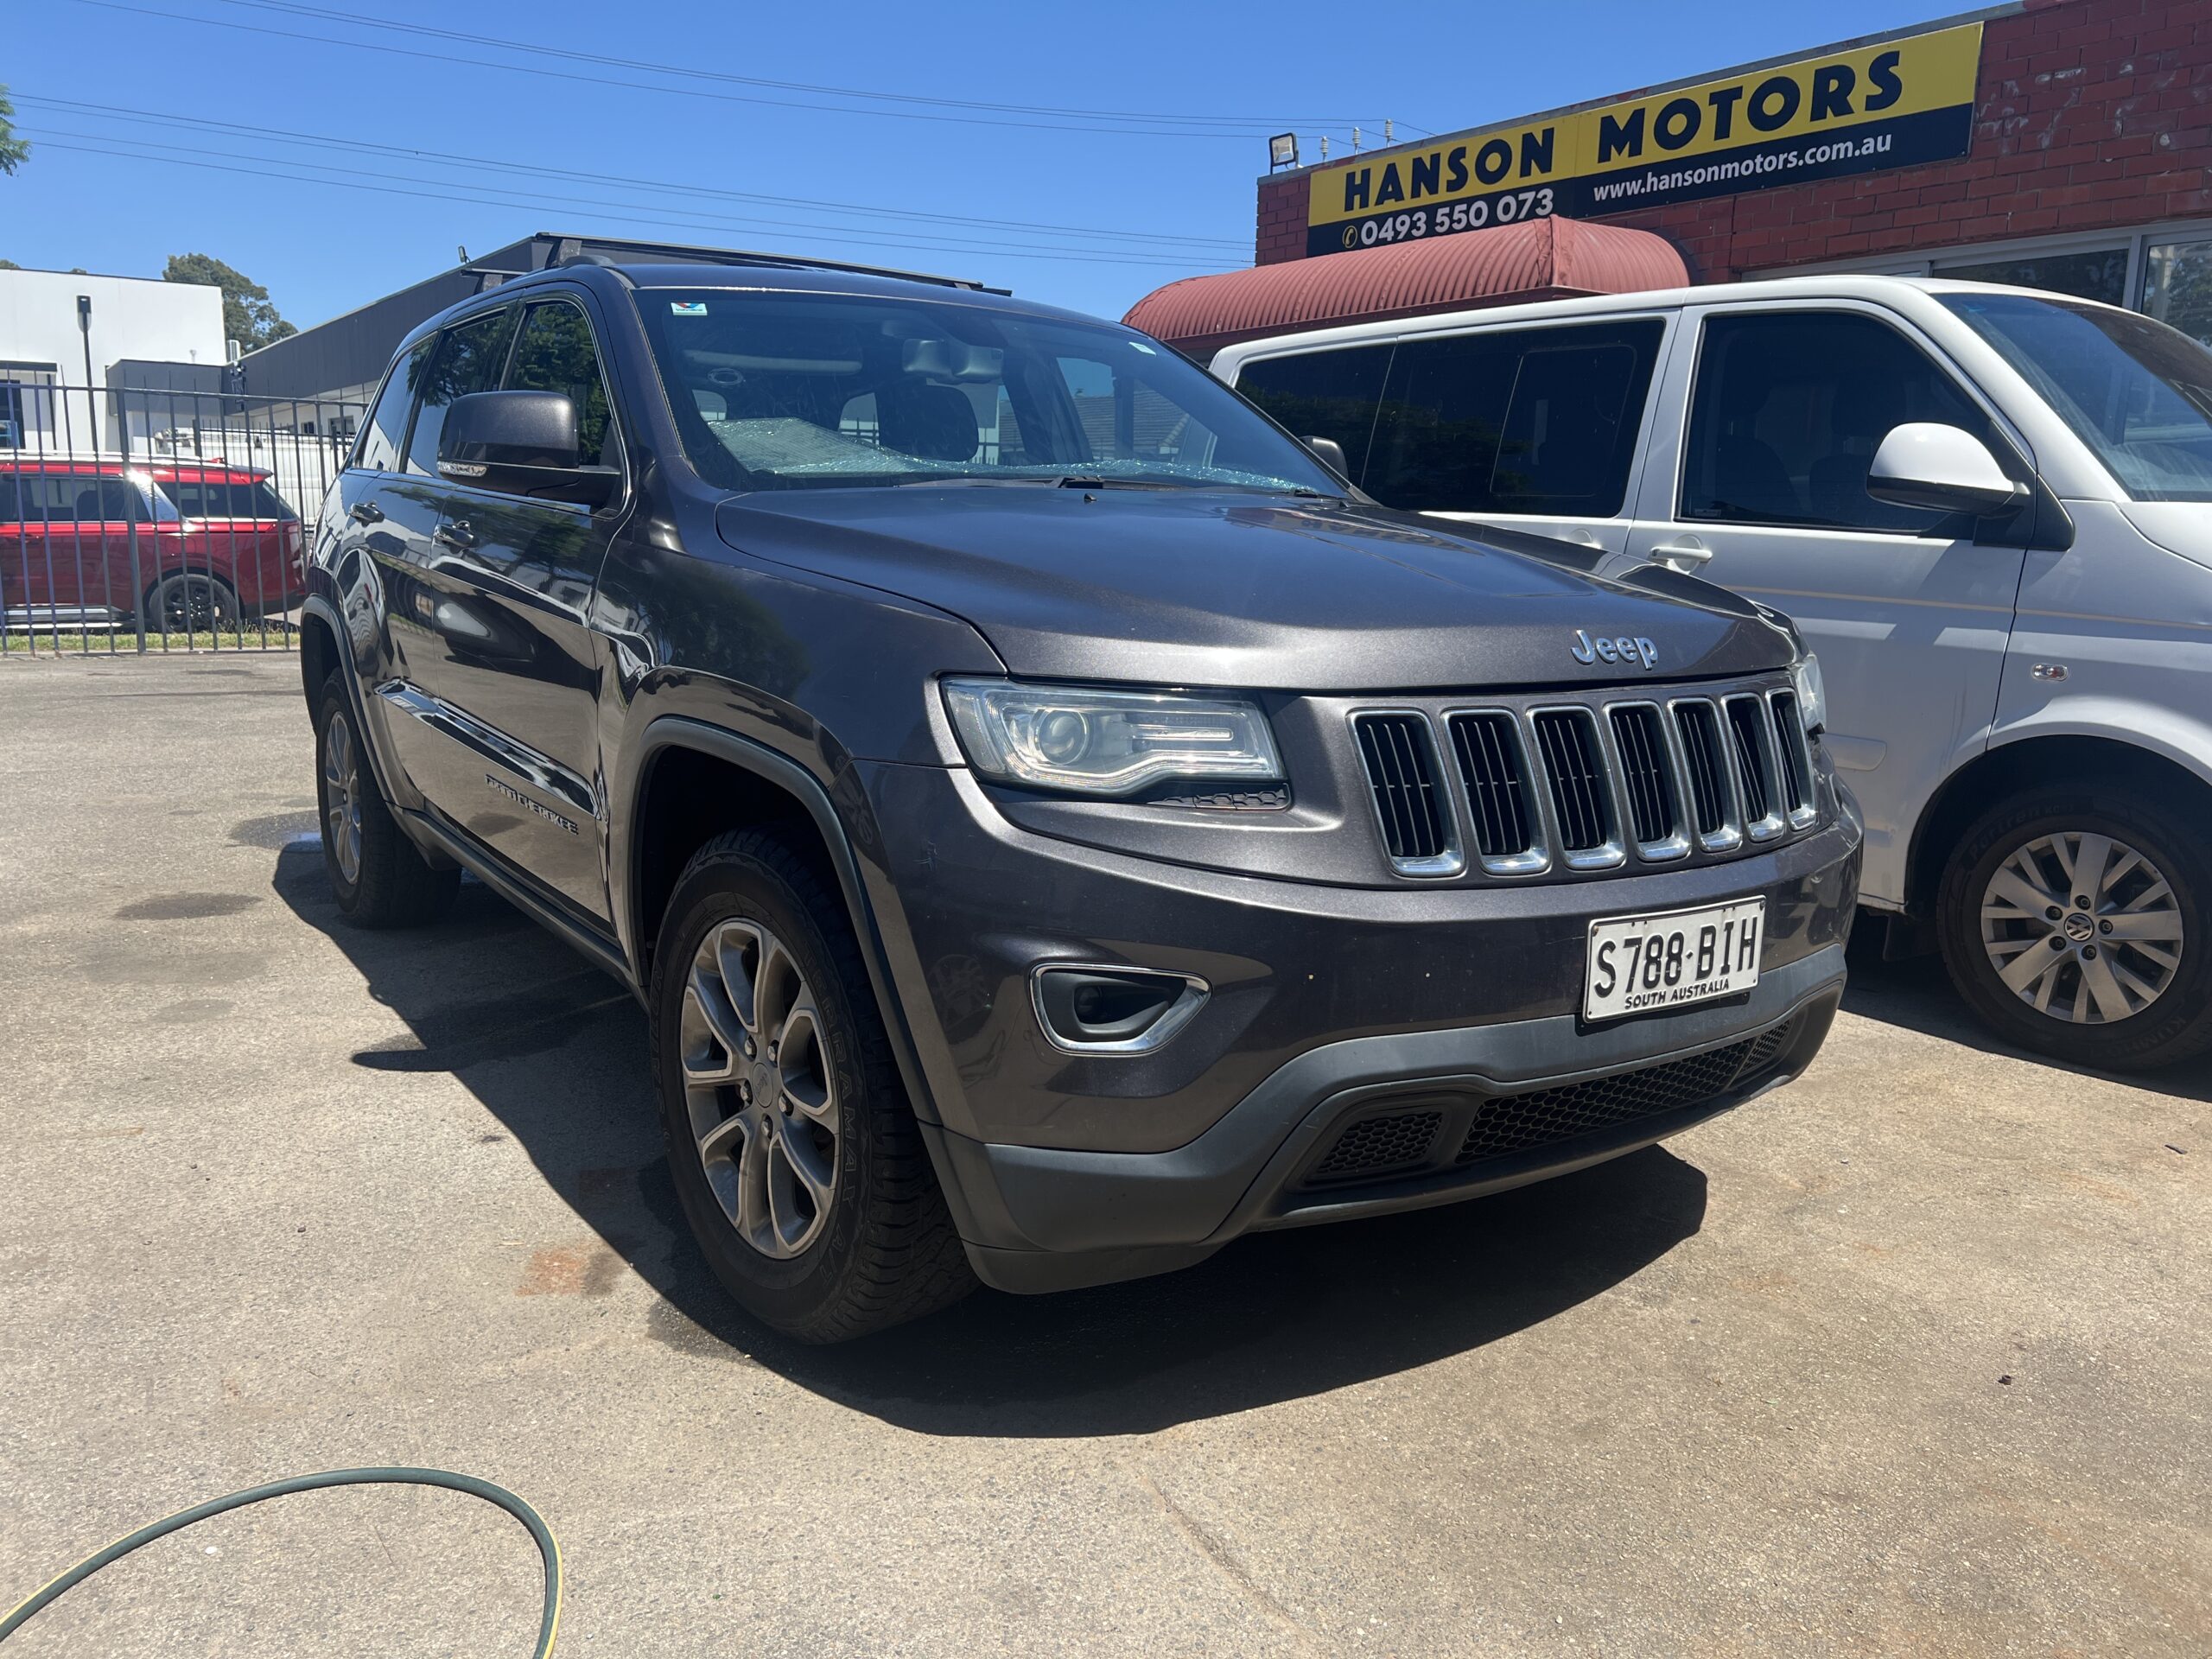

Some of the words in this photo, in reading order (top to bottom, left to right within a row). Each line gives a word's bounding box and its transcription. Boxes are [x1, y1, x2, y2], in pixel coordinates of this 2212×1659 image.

[1344, 127, 1554, 212] HANSON
[1598, 50, 1902, 163] MOTORS
[1593, 133, 1892, 201] www.hansonmotors.com.au
[1360, 211, 1427, 246] 0493
[1434, 200, 1488, 233] 550
[1497, 188, 1554, 222] 073
[1571, 630, 1658, 670] Jeep
[1624, 990, 1667, 1010] SOUTH
[1670, 978, 1730, 1002] AUSTRALIA
